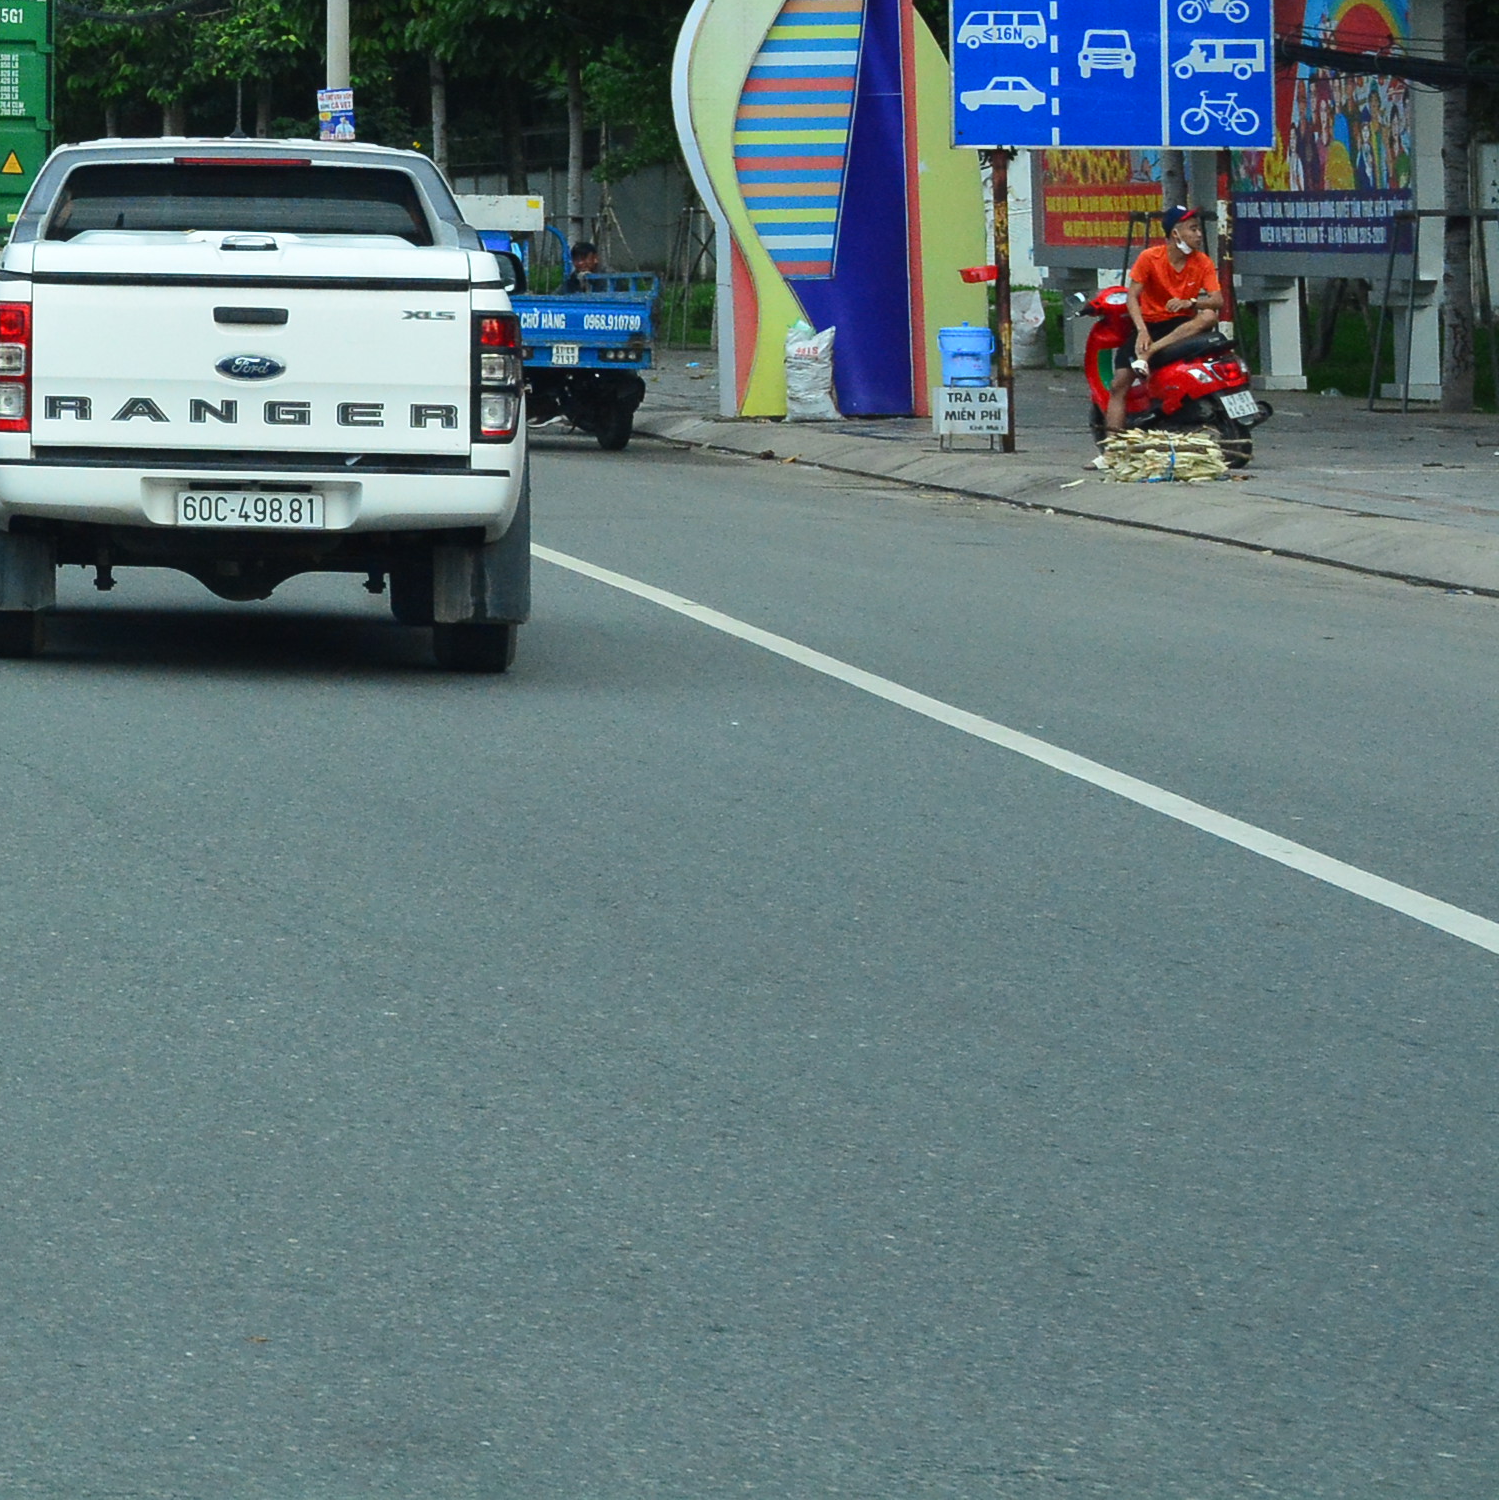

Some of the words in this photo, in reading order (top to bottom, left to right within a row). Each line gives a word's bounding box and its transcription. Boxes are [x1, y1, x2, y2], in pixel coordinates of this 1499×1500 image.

[401, 310, 456, 321] XLS
[520, 308, 540, 328] CHỞ
[541, 309, 565, 329] HÀNG
[583, 314, 641, 331] 0968.910780
[231, 356, 271, 376] Ford
[947, 390, 973, 403] TRÀ
[44, 395, 459, 428] RANGER
[981, 408, 1002, 420] PHÍ
[183, 496, 315, 524] 60C-498.81
